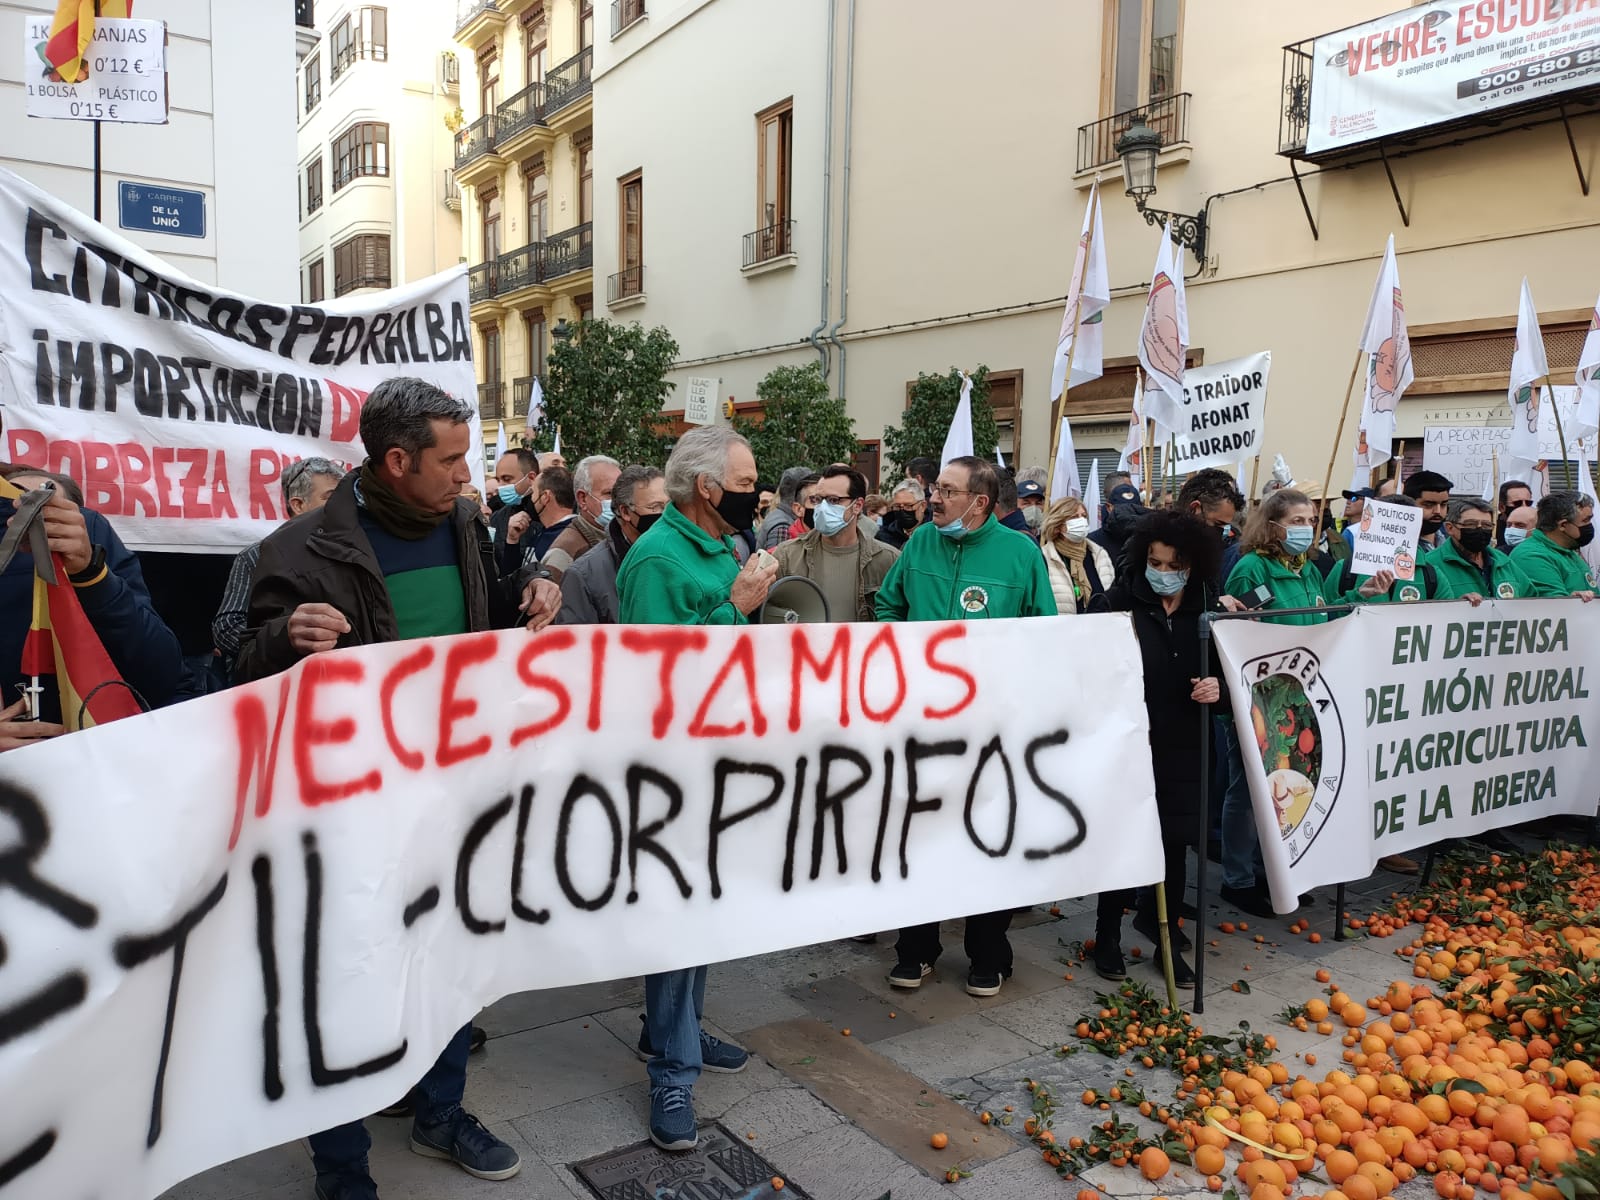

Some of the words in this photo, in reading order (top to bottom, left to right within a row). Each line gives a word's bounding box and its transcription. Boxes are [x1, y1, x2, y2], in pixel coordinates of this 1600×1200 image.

[1347, 15, 1446, 77] VEURE,
[1476, 44, 1494, 56] dona
[133, 59, 144, 74] €
[1478, 70, 1520, 90] 900
[1526, 56, 1571, 78] 580
[28, 85, 35, 96] 1
[38, 85, 78, 98] BOLSA
[99, 86, 158, 102] PLÁSTICO
[108, 104, 118, 118] €
[152, 205, 165, 214] DE
[167, 207, 180, 216] LA
[152, 216, 180, 228] UNIÓ
[1194, 371, 1262, 402] TRAÏDOR
[1191, 402, 1250, 432] AFONAT
[1426, 430, 1444, 443] LA
[1360, 532, 1395, 546] ARRUINADO
[1402, 540, 1411, 548] AL
[1354, 552, 1394, 565] AGRICULTOR
[1392, 624, 1432, 665] EN
[1443, 618, 1568, 660] DEFENSA
[1365, 684, 1410, 728] DEL
[1422, 668, 1494, 716] MÓN
[1503, 666, 1590, 707] RURAL
[230, 623, 977, 850] NECESITAMOS
[1375, 714, 1588, 782] L'AGRICULTURA
[1374, 794, 1406, 841] DE
[1418, 784, 1454, 826] LA
[1471, 766, 1557, 816] RIBERA
